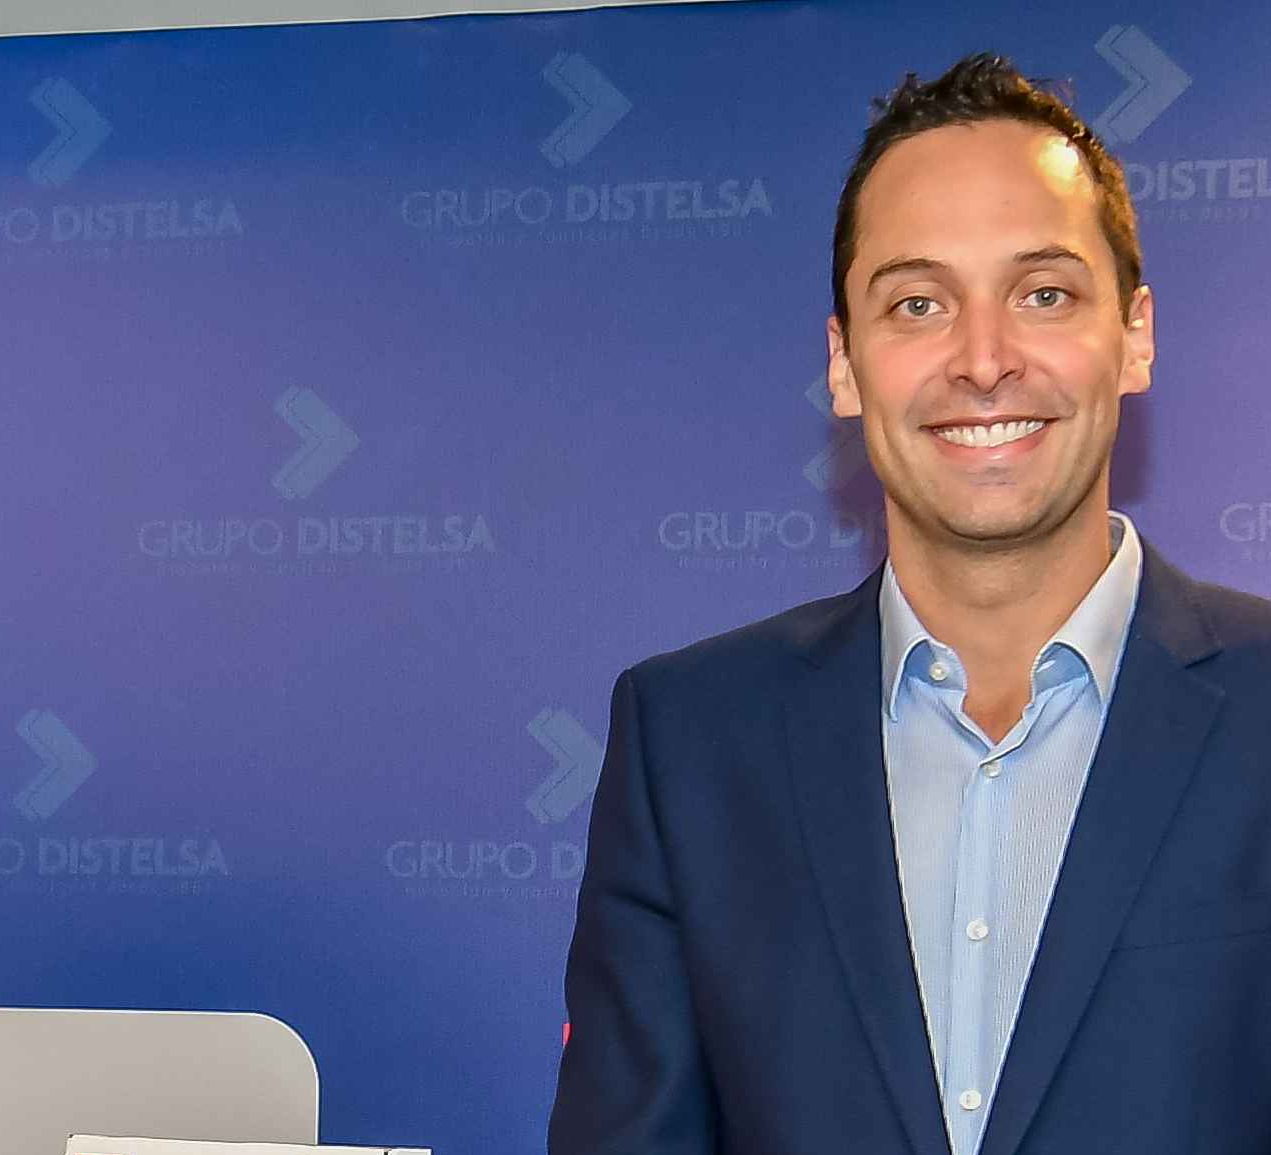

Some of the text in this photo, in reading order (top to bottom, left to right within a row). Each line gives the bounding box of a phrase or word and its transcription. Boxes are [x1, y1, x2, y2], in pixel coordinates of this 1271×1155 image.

[52, 199, 243, 242] DISTELSA
[401, 179, 773, 228] GRUPO DISTELSA
[138, 513, 496, 557] GRUPO DISTELSA
[658, 511, 816, 551] GRUPO
[38, 837, 229, 876] DISTELSA
[386, 840, 536, 880] GRUPO
